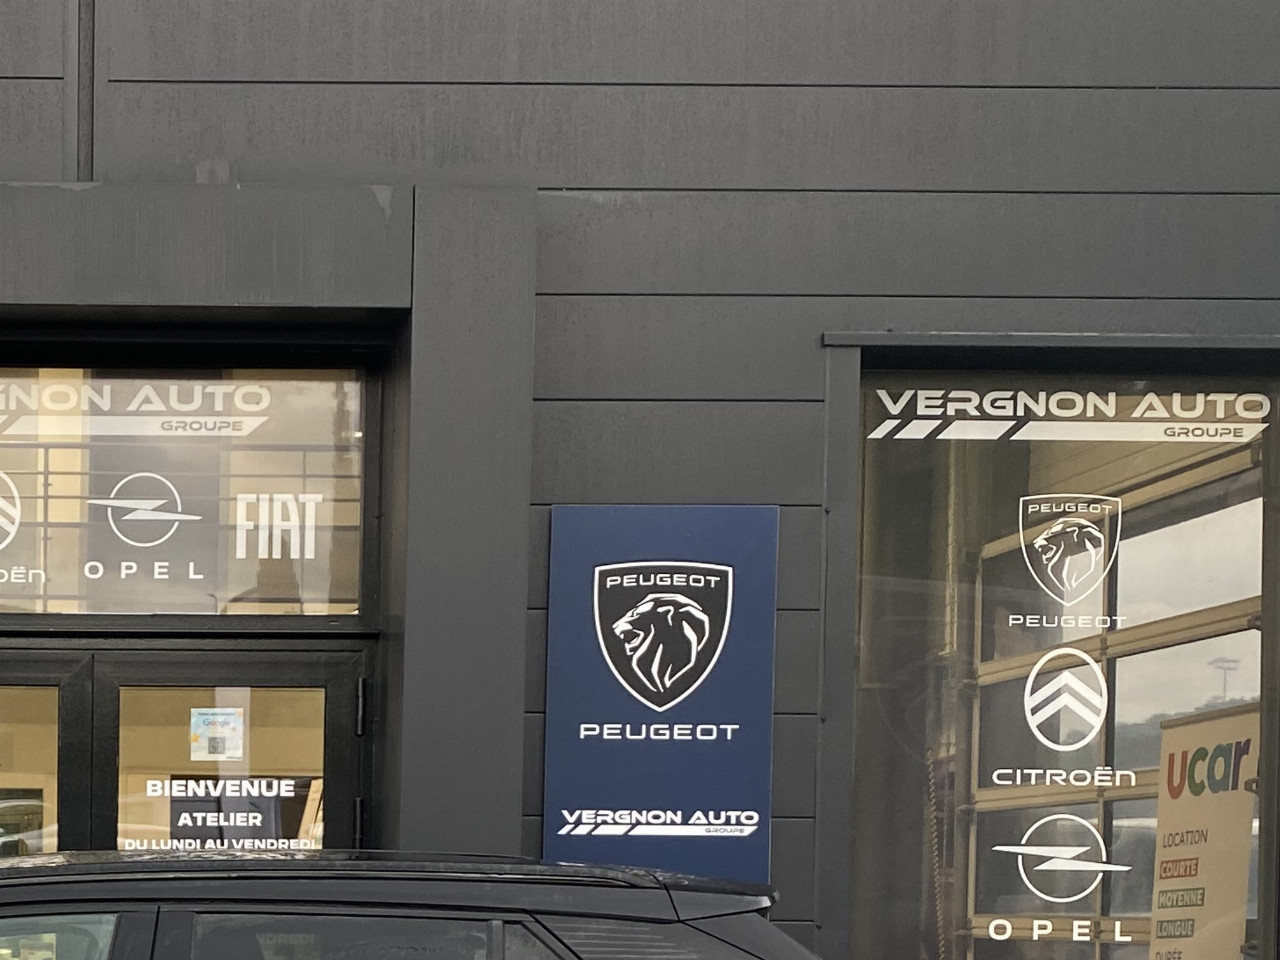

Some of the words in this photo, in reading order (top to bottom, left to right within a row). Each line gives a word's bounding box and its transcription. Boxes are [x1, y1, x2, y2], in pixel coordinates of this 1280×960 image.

[126, 384, 272, 412] AUTO
[876, 389, 1116, 418] VERGNON
[1131, 392, 1272, 419] AUTO
[160, 420, 244, 432] GROUPE
[1164, 427, 1244, 438] GROUPE
[1028, 503, 1113, 514] PEUGEOT
[236, 493, 323, 560] FIAT
[83, 561, 205, 580] OPEL
[606, 574, 721, 588] PEUGEOT
[1008, 615, 1127, 628] PEUGEOT
[579, 724, 740, 741] PEUGEOT
[1167, 738, 1252, 800] ucar
[146, 779, 295, 798] BIENVENUE
[177, 812, 262, 827] ATELIER
[561, 809, 682, 825] VERGNON
[688, 810, 760, 825] AUTO
[124, 839, 148, 850] DU
[152, 839, 201, 850] LUNDI
[204, 839, 229, 850] AU
[233, 839, 316, 850] VENDREDI
[1162, 829, 1209, 848] LOCATION
[1161, 859, 1198, 878] COURTE
[1158, 889, 1204, 908] MOYENNE
[988, 919, 1133, 942] OPEL
[1157, 920, 1194, 937] LONGUE
